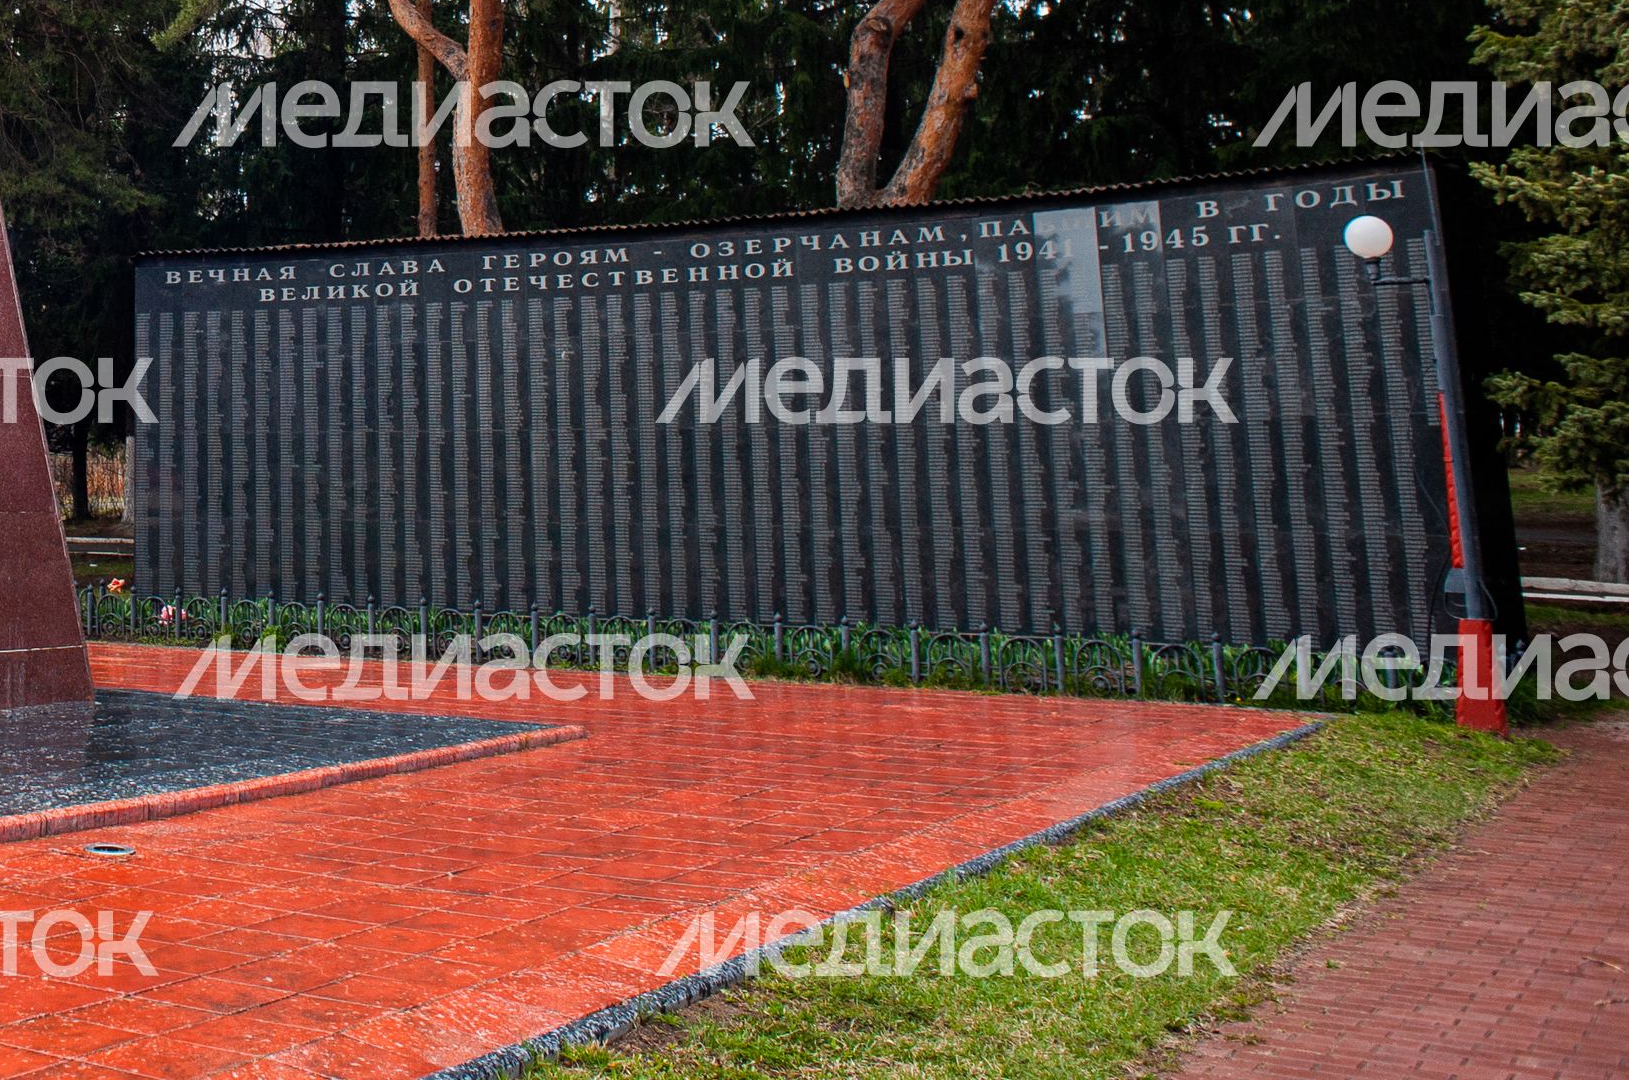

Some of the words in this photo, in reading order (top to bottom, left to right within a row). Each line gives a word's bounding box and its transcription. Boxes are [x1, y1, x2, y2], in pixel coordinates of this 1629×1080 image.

[165, 265, 297, 285] ВЕЧНАЯ
[329, 258, 446, 279] СЛАВА
[482, 247, 630, 270] ГЕРОЯМ
[1197, 200, 1221, 220] В
[1265, 179, 1406, 212] ГОДЫ
[259, 279, 419, 303] ВЕЛИКОЙ
[453, 258, 795, 294] ОТЕЧЕСТВЕННОЙ
[834, 248, 975, 275] ВОЙНЫ
[1227, 223, 1281, 244] ГГ.
